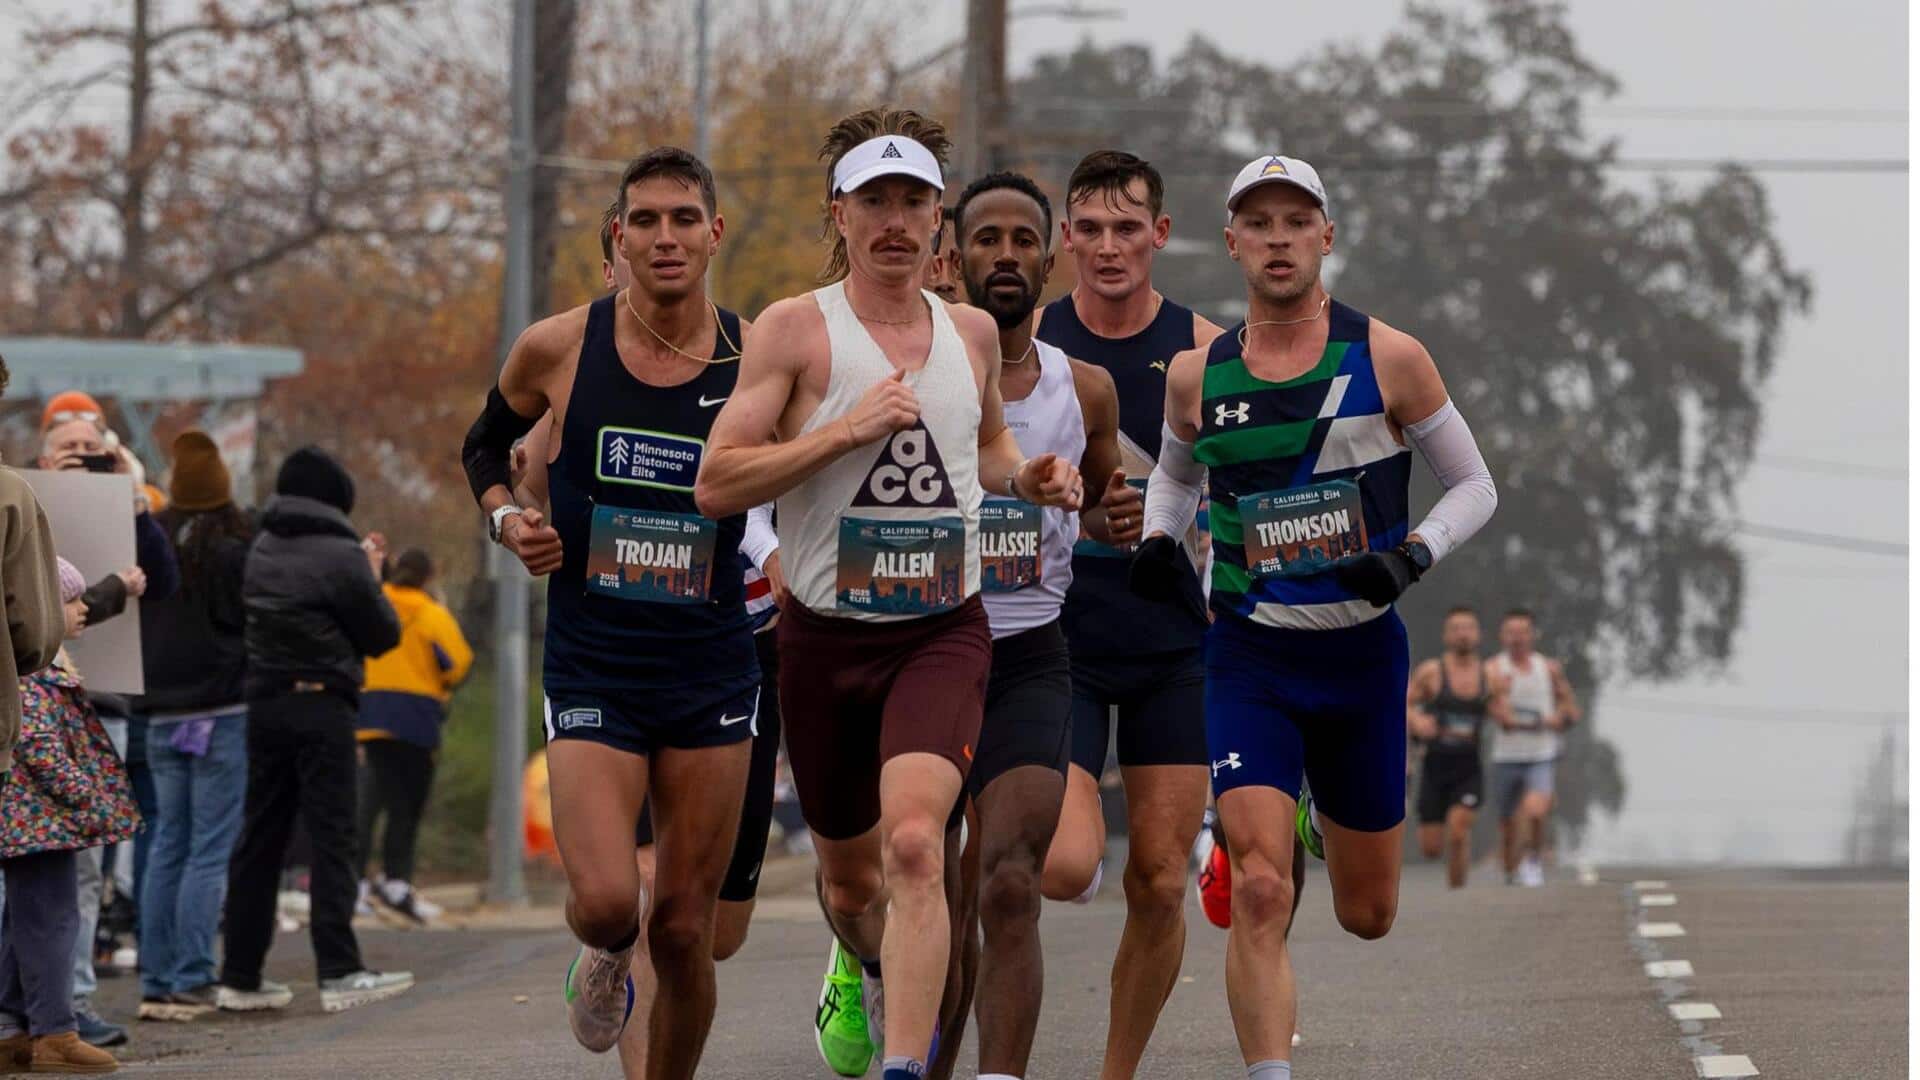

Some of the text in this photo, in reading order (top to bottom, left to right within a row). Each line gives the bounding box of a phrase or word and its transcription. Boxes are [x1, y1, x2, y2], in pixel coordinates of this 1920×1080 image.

[634, 442, 695, 462] Minnesota
[633, 455, 683, 471] Distance
[631, 466, 656, 479] Elite
[1273, 491, 1320, 505] CALIFORNIA
[631, 516, 679, 526] CALIFORNIA
[880, 527, 929, 535] CALIFORNIA
[1256, 509, 1351, 547] THOMSON
[615, 538, 692, 569] TROJAN
[872, 551, 935, 578] ALLEN
[1262, 564, 1281, 573] ELITE
[599, 580, 620, 588] ELITE
[849, 595, 871, 604] ELITE
